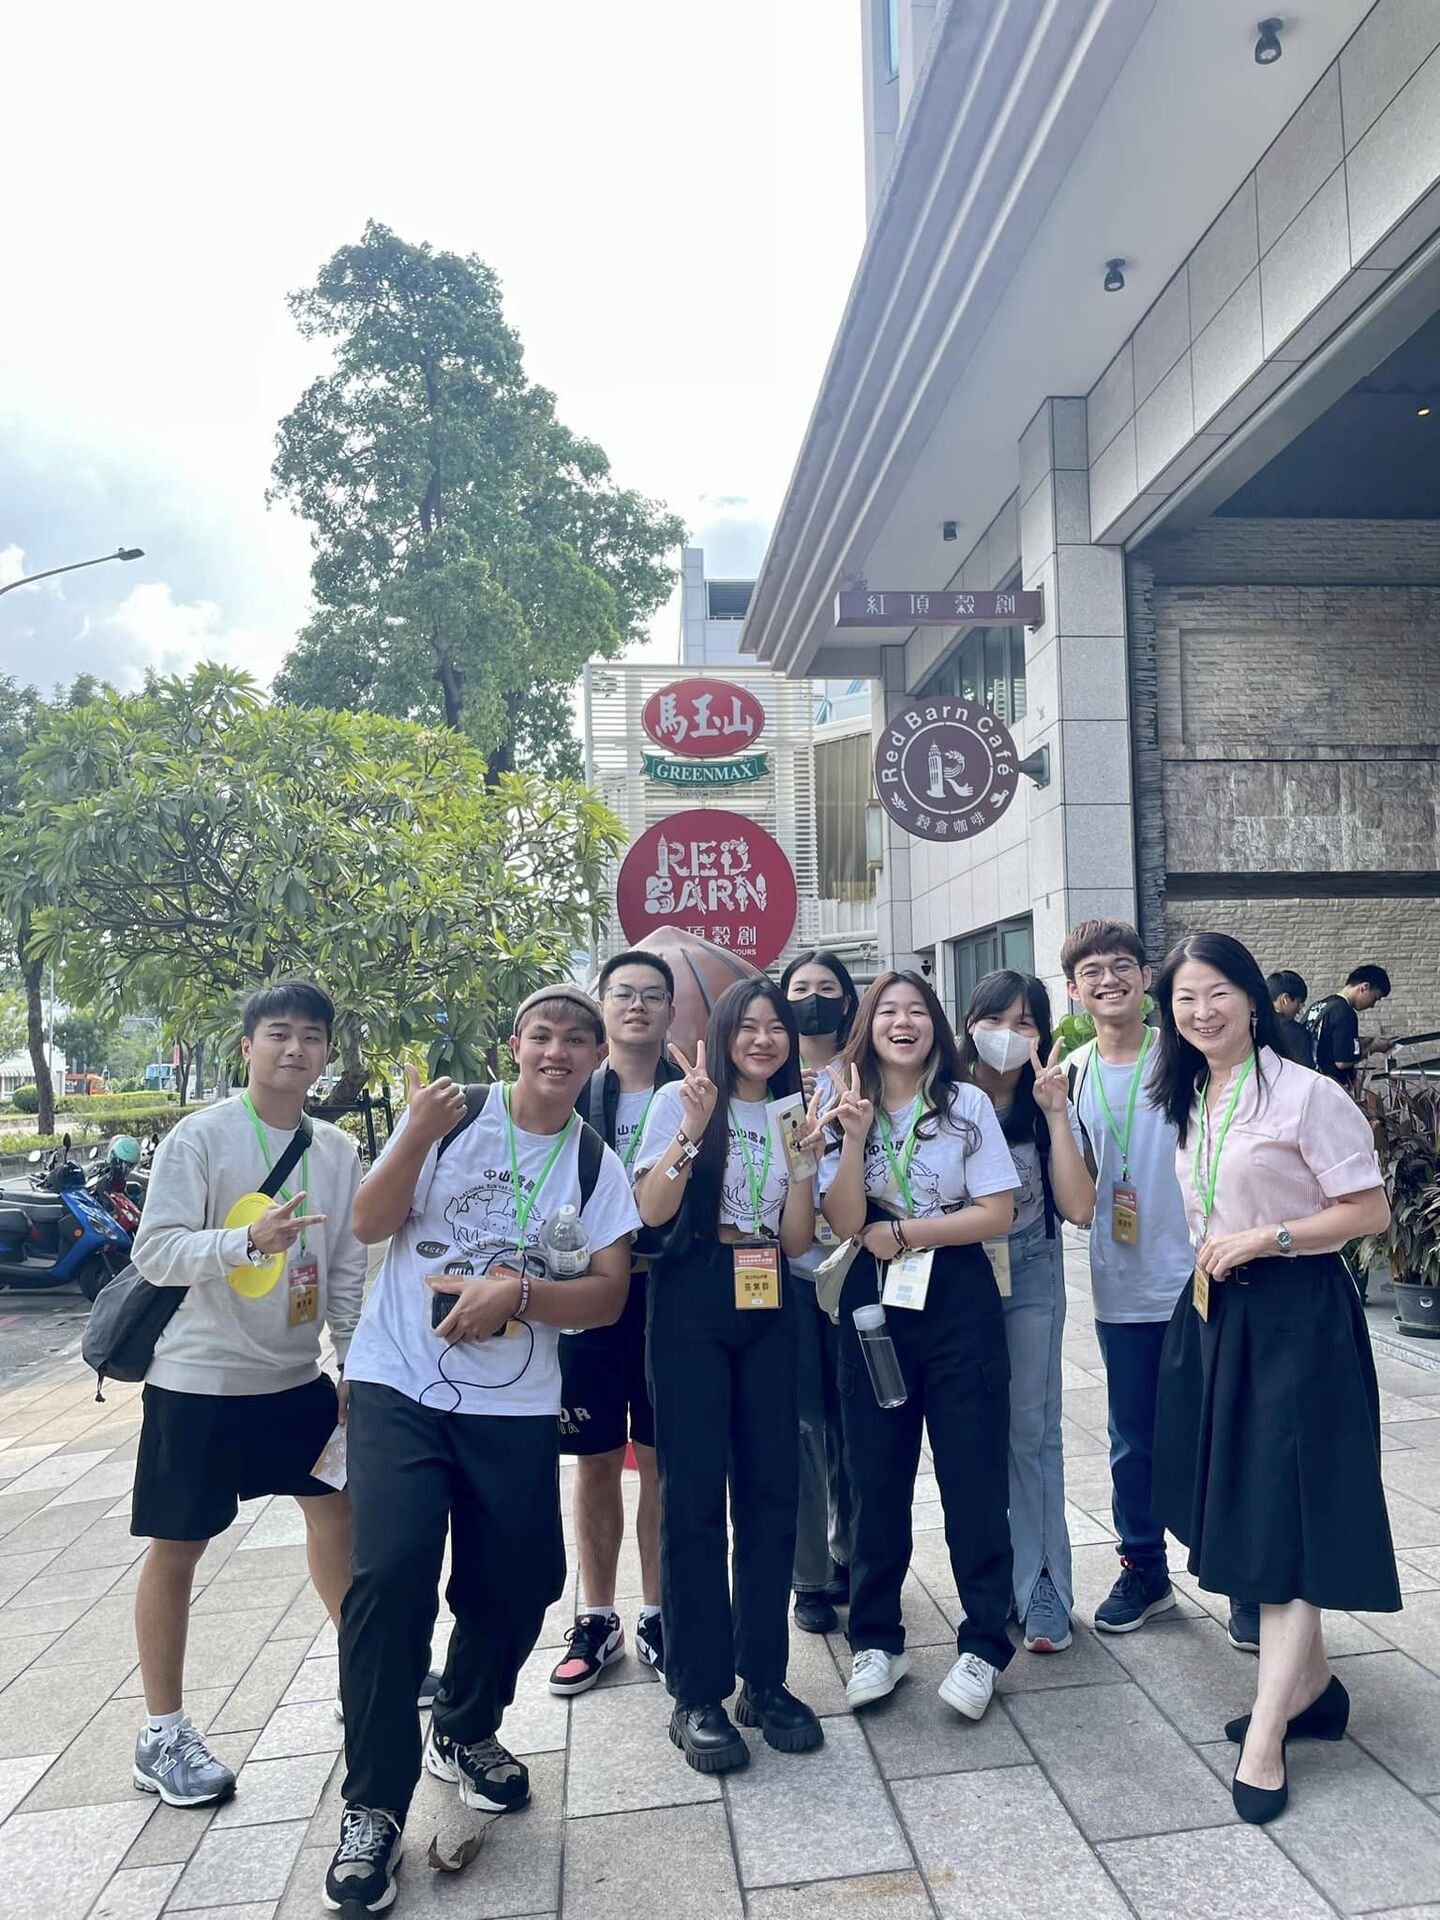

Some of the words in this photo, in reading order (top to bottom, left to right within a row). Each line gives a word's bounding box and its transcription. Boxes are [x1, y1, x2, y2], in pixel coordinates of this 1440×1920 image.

[655, 693, 754, 743] 馬玉山
[881, 731, 906, 783] Red
[904, 706, 969, 730] Barn
[976, 716, 1014, 776] Café
[656, 763, 754, 781] GREENMAX
[656, 833, 751, 877] RED
[644, 873, 767, 915] BARN
